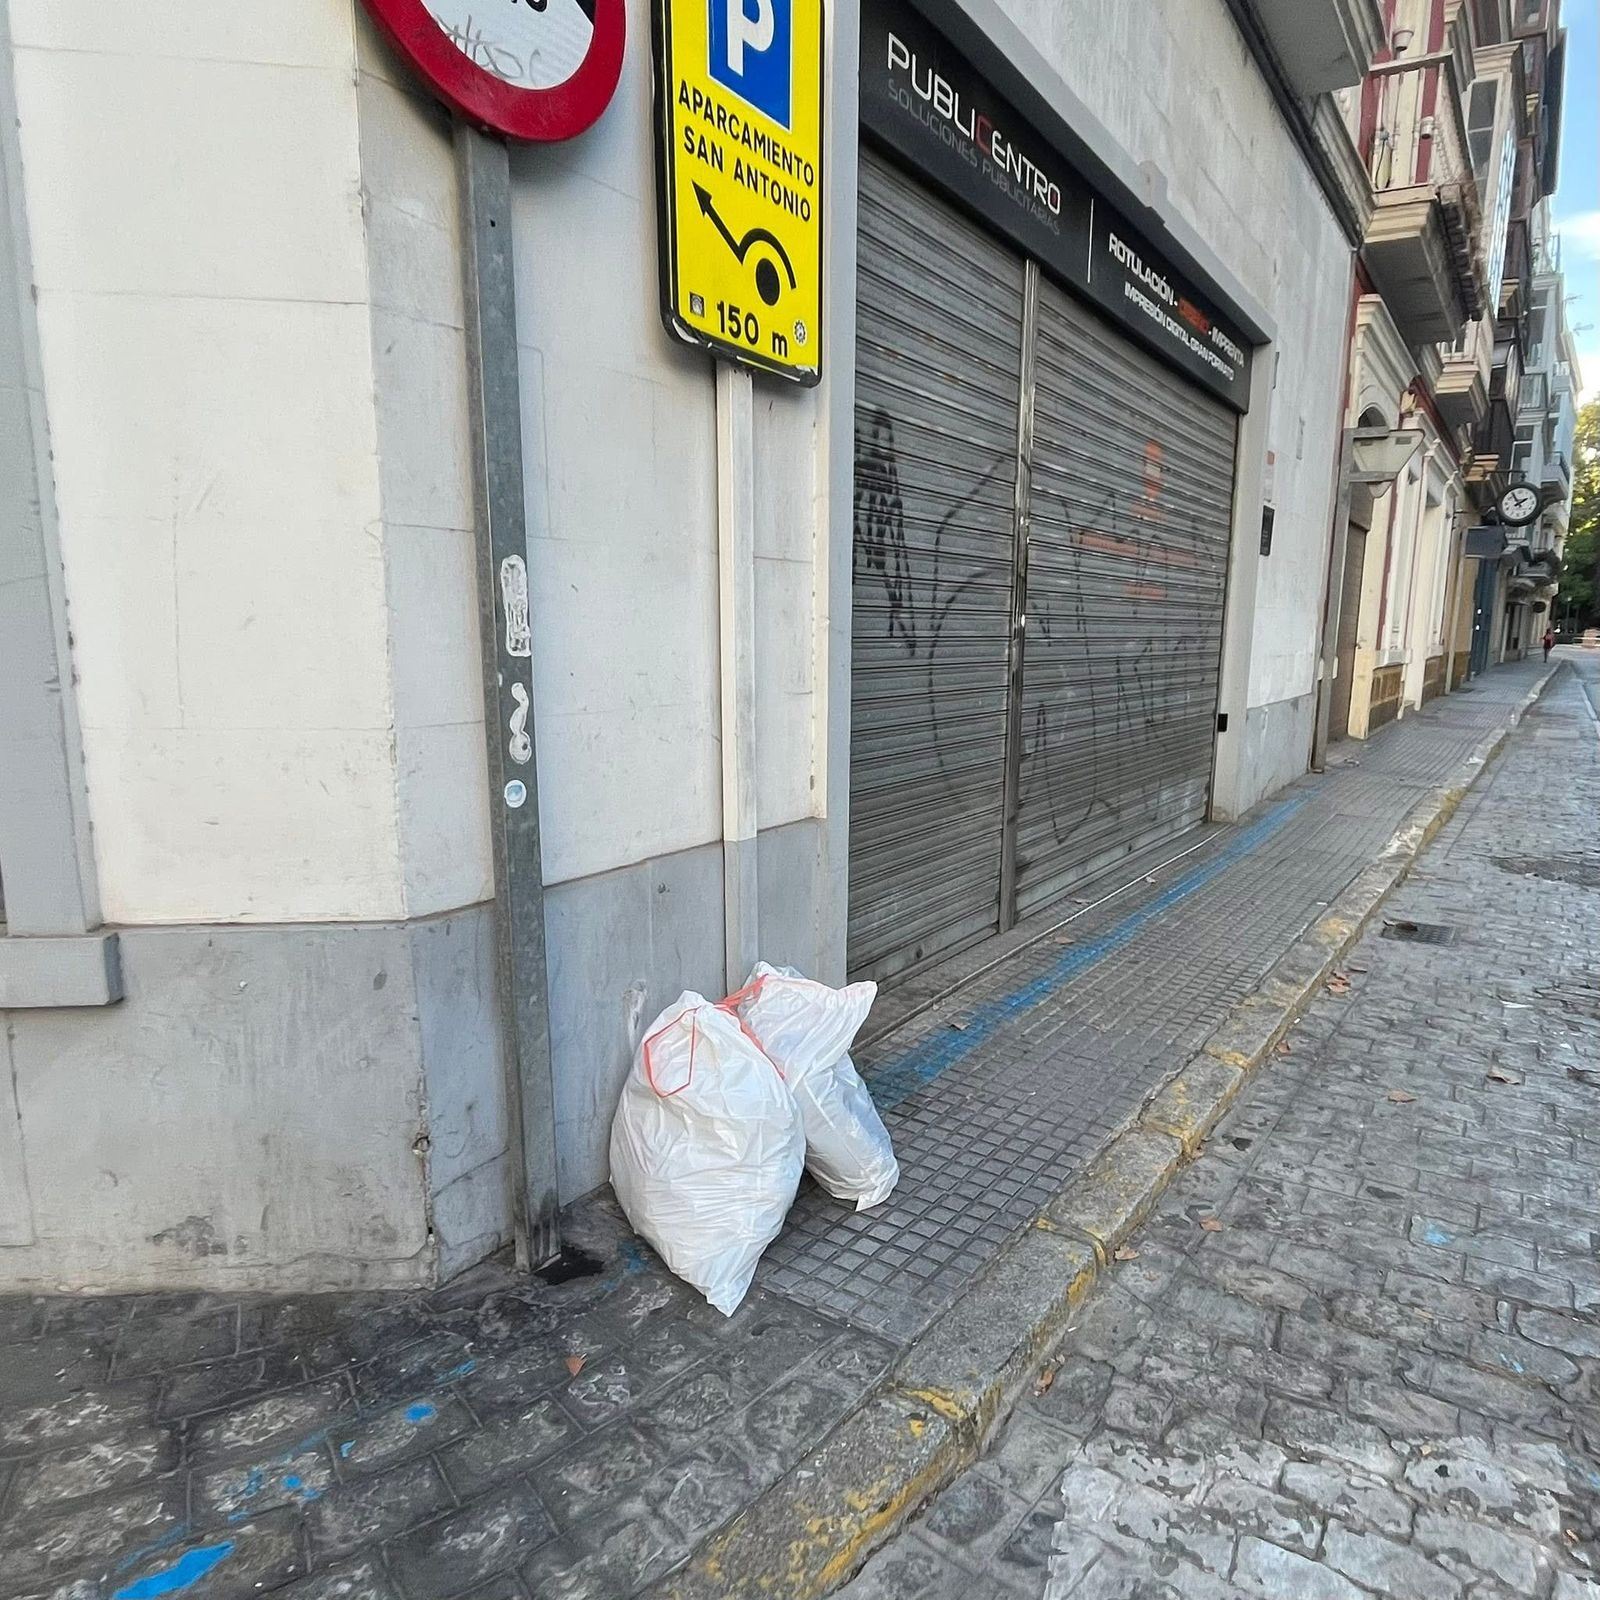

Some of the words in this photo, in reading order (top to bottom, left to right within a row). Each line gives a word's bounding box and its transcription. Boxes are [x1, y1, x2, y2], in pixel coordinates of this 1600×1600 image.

[727, 0, 774, 77] P
[678, 79, 814, 187] APARCAMIENTO
[887, 31, 1061, 215] PUBLICENTRO
[887, 78, 978, 168] SOLUCIONES
[683, 126, 724, 173] SAN
[733, 156, 811, 222] ANTONIO
[717, 300, 759, 345] 150
[771, 331, 788, 358] m
